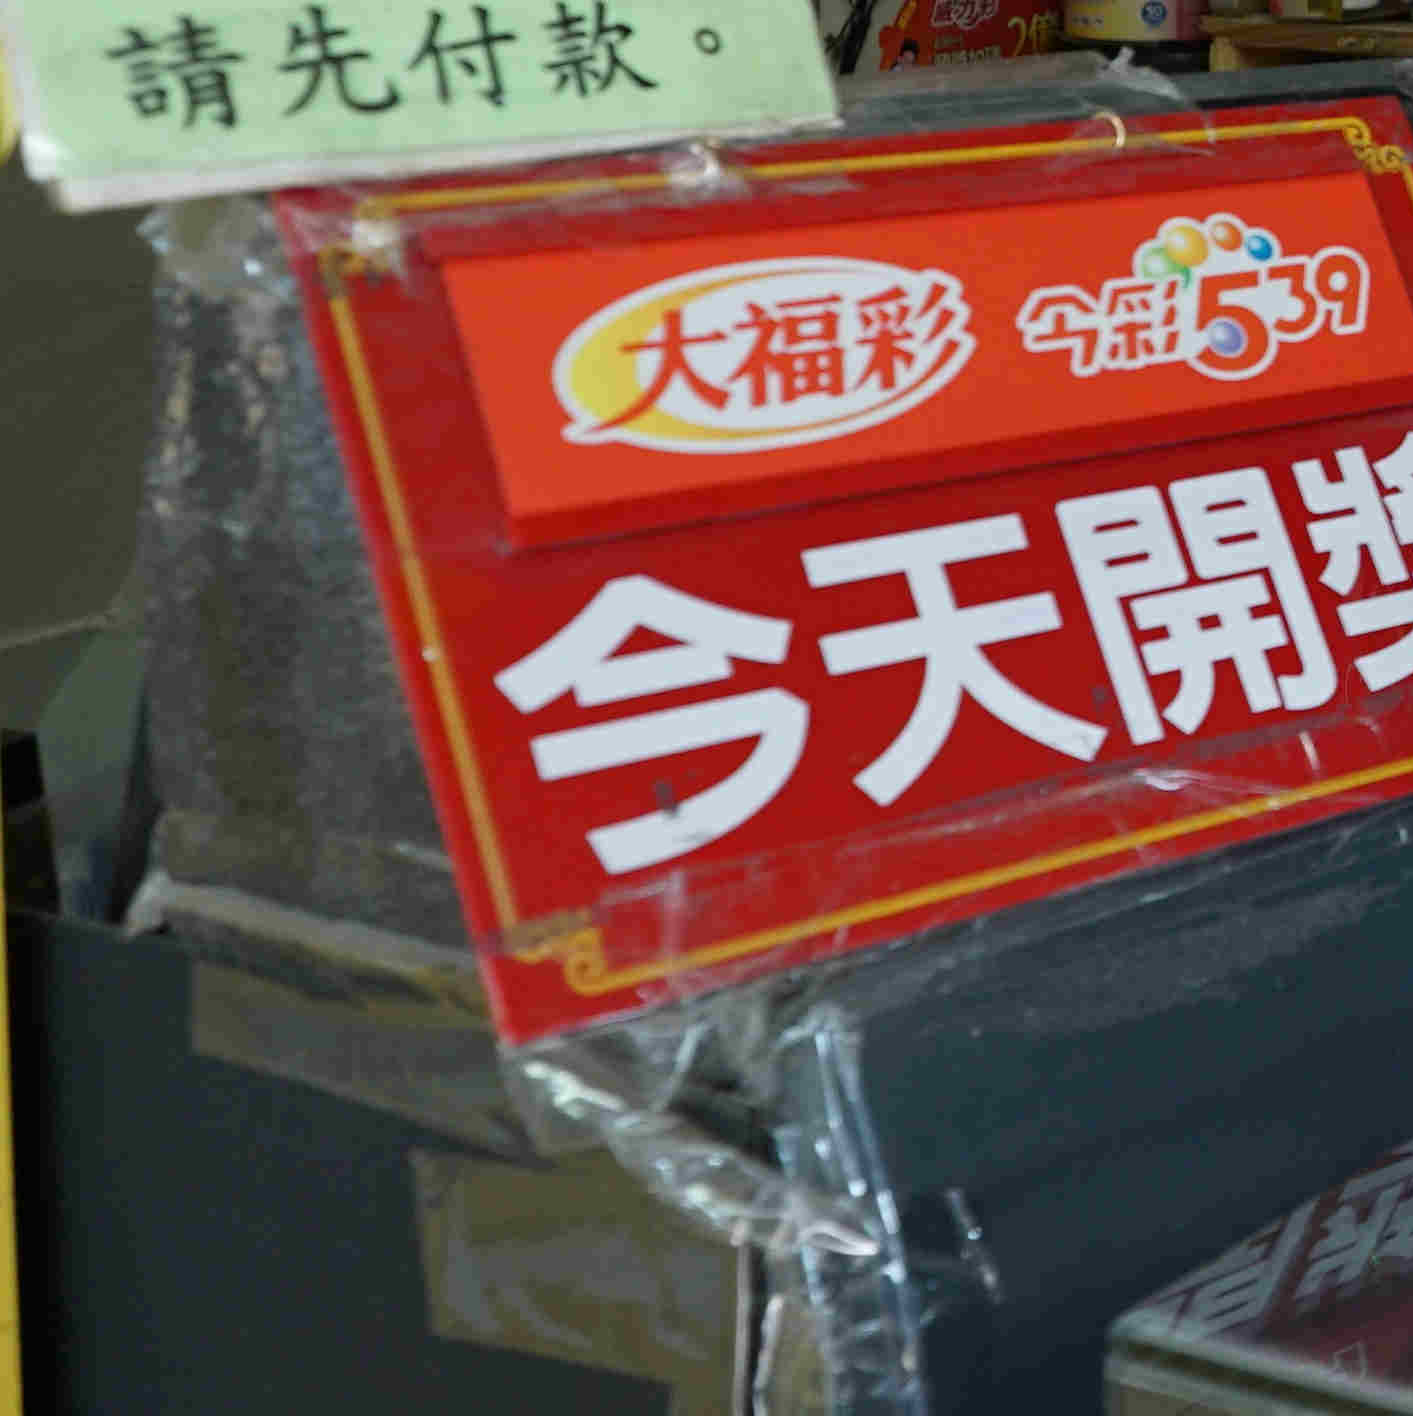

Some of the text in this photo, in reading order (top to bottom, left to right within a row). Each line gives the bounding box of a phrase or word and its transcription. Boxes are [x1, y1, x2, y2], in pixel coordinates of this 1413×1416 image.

[104, 0, 722, 130] 請先付款。
[590, 281, 968, 432] 大福彩
